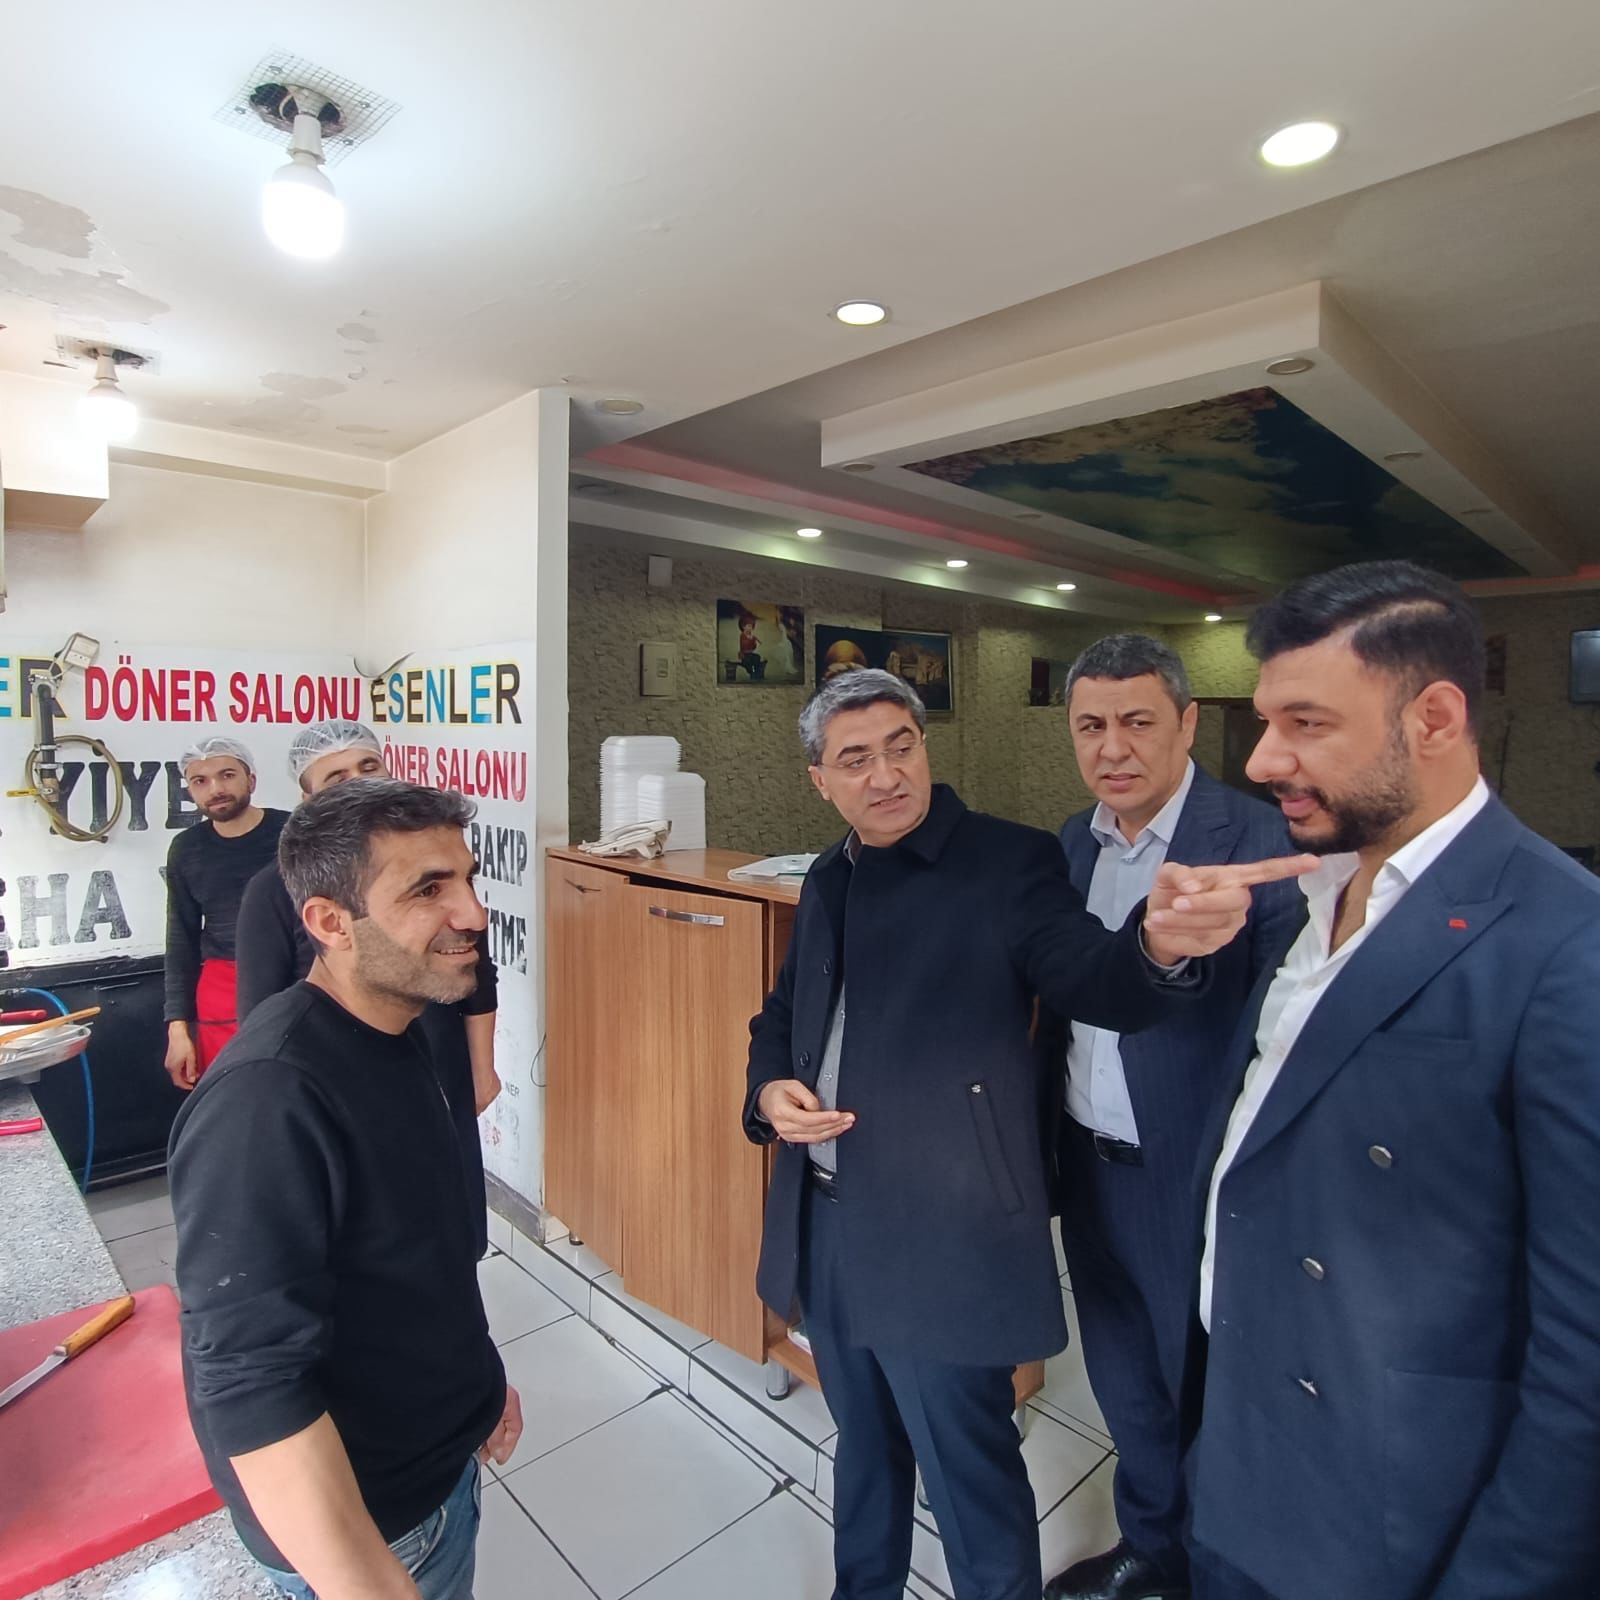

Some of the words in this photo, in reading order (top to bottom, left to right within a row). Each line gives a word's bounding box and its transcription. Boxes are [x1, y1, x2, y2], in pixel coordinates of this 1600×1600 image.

[85, 655, 217, 722] DÖNER
[229, 671, 361, 724] SALONU
[371, 663, 522, 724] ESENLER
[436, 746, 527, 802] SALONU
[471, 822, 527, 887] BAKIP
